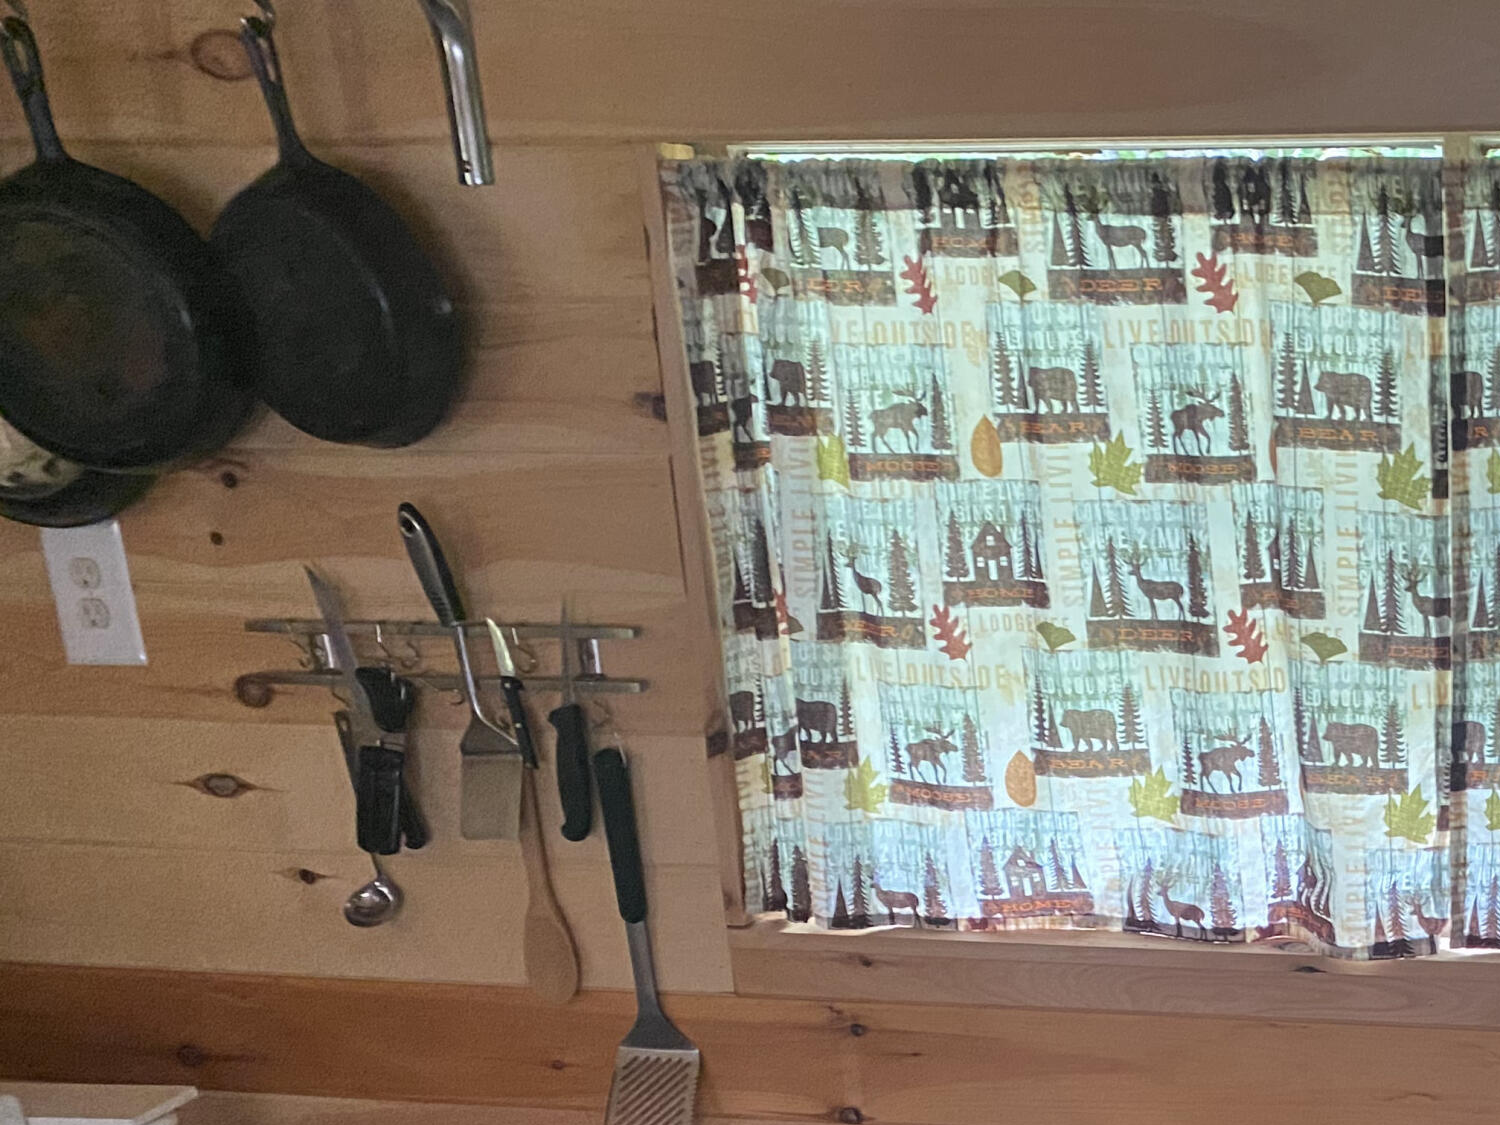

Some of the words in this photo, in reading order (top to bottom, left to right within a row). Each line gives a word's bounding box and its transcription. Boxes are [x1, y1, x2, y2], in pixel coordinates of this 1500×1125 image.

[1079, 278, 1162, 292] DEER
[1103, 319, 1158, 349] LIVE
[1019, 423, 1085, 433] BEAR
[1300, 427, 1376, 441] BEAR
[1052, 517, 1084, 609] SIMPLE
[1335, 526, 1360, 618] SIMPLE
[1119, 629, 1192, 641] DEER
[1145, 666, 1192, 692] LIVE
[1200, 668, 1286, 694] OUTSID
